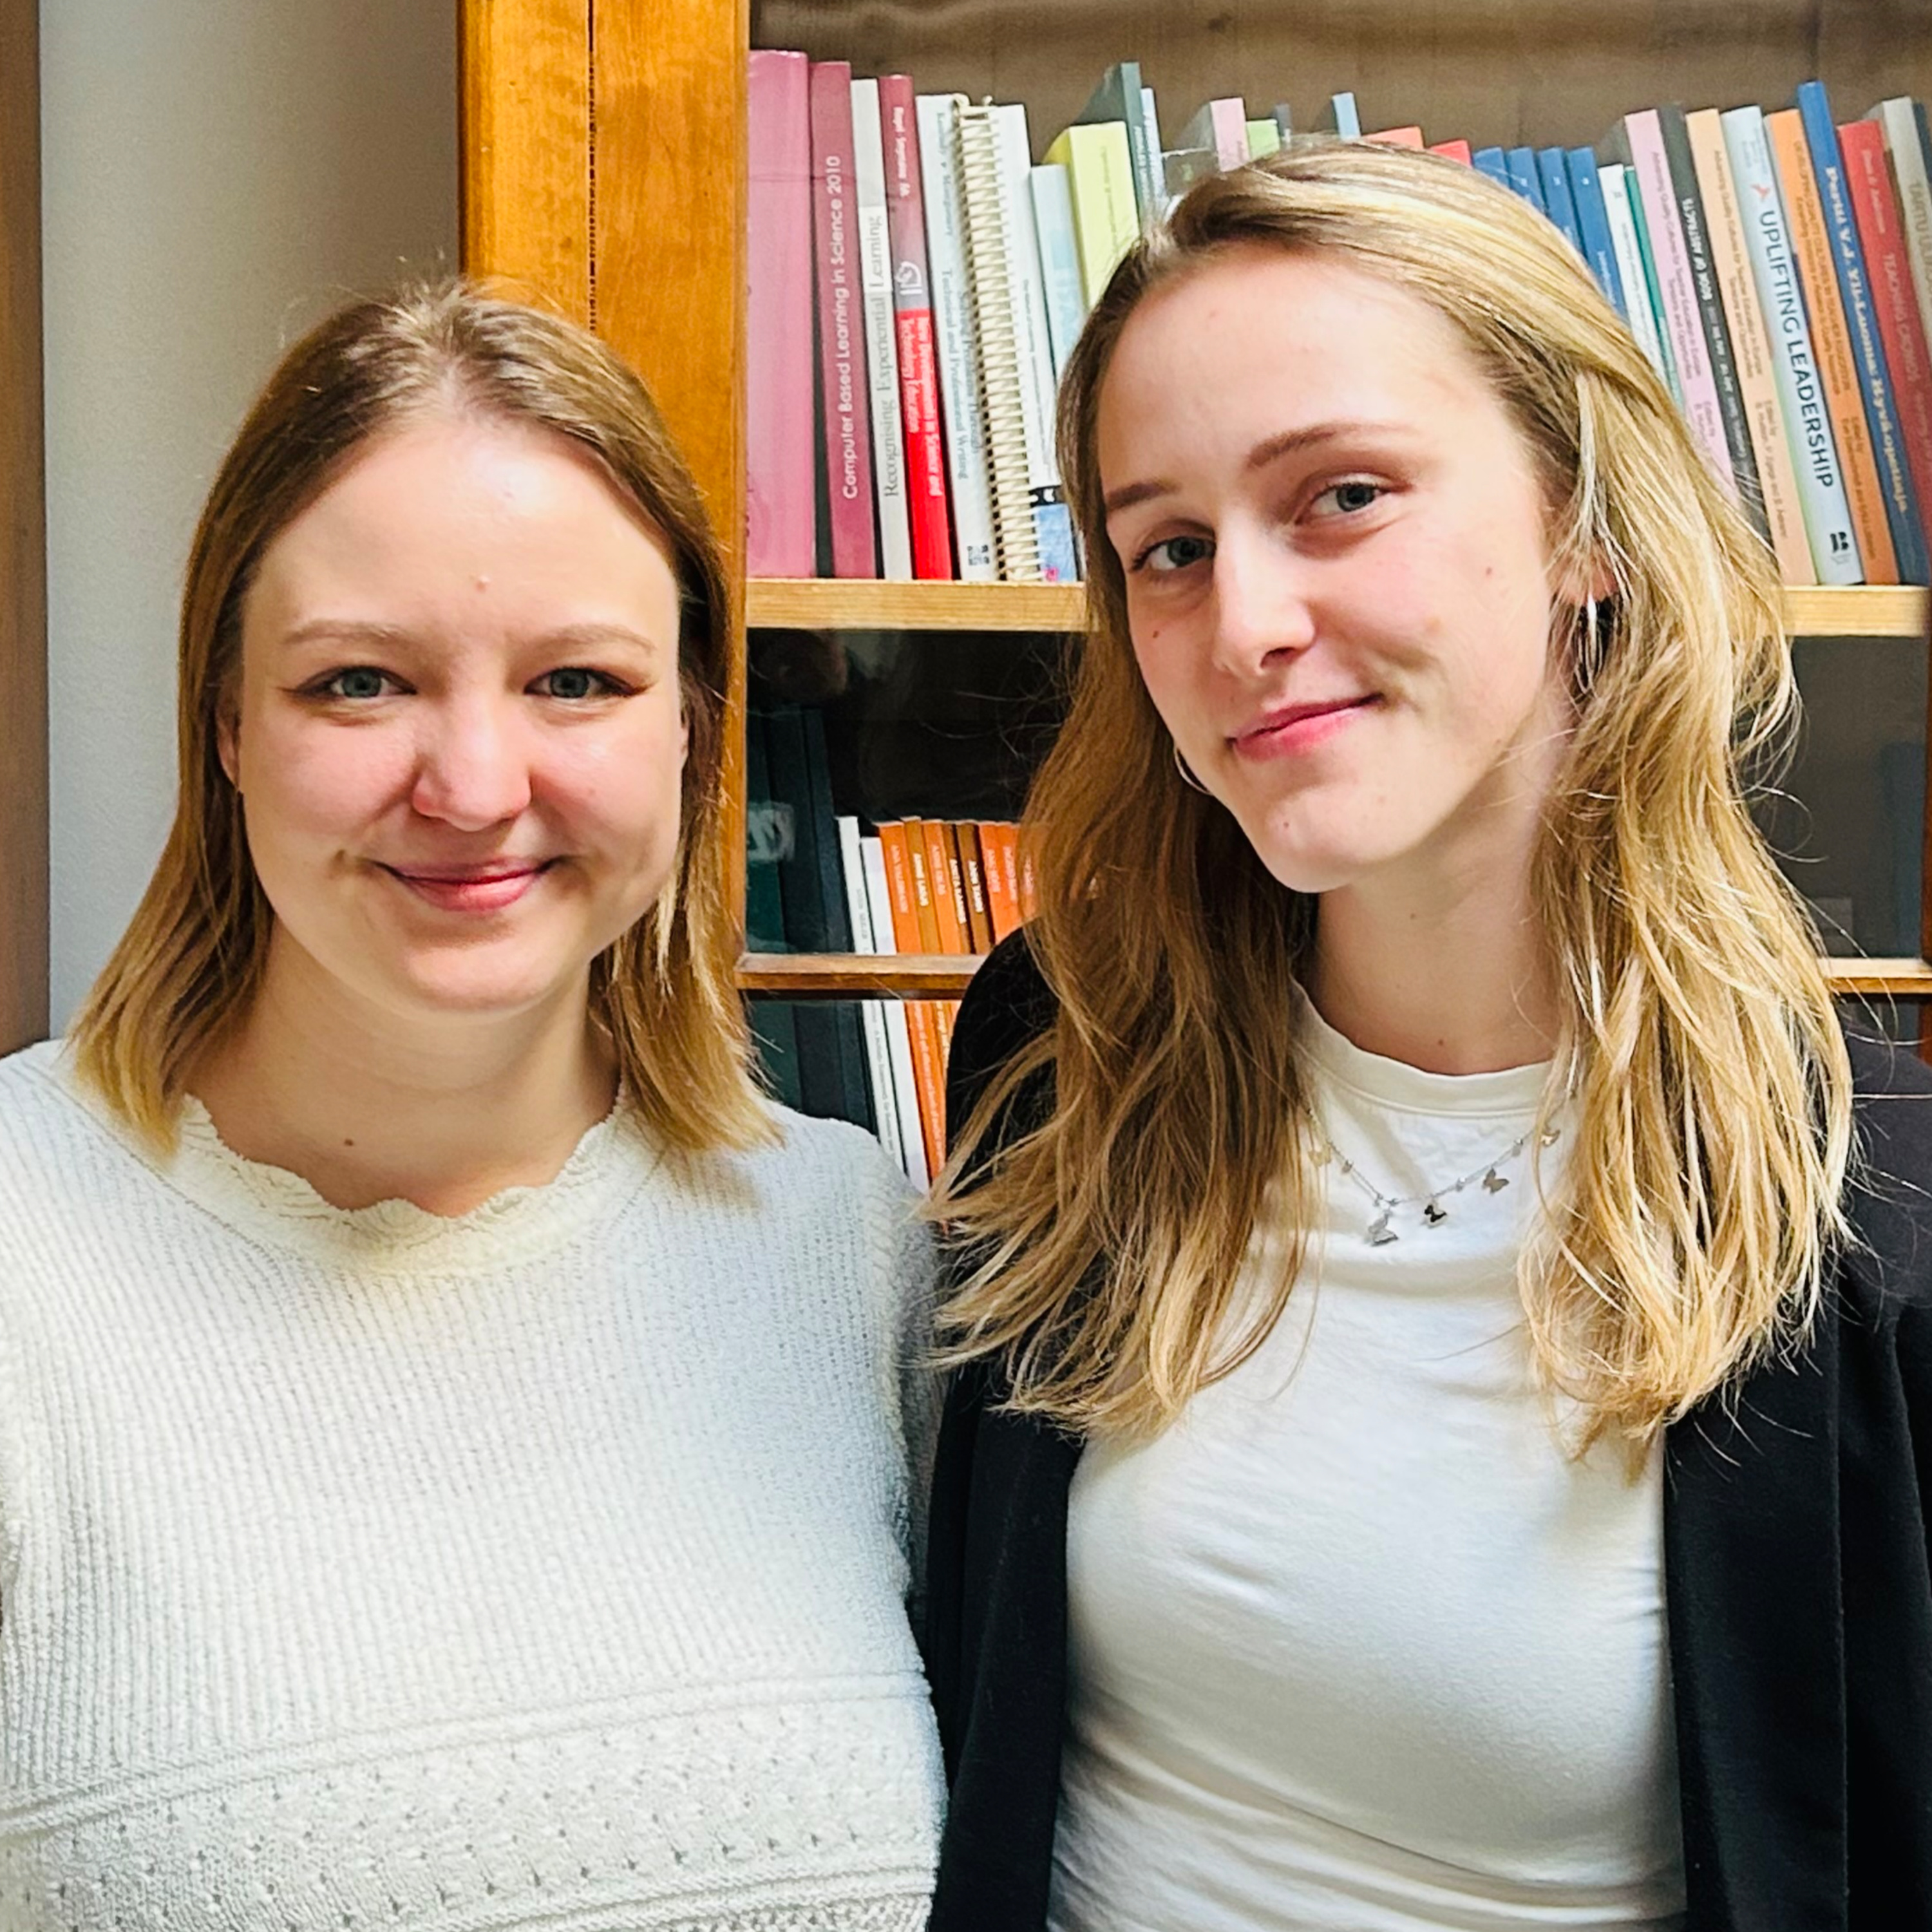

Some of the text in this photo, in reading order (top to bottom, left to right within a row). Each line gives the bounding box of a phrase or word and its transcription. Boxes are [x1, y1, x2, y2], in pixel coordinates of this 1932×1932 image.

[1824, 166, 1847, 224] Pertti
[1680, 197, 1713, 301] BOOK OF ABSTRACTS
[1679, 298, 1699, 338] Education
[1742, 298, 1756, 335] Education
[1846, 267, 1880, 376] Yli-Luoma:
[1880, 252, 1909, 322] TEACHING
[825, 156, 859, 498] Computer Based Learning in Science 2010
[868, 216, 901, 497] Recognising Experiential Learning
[1757, 209, 1835, 489] UPLIFTING LEADERSHIP
[941, 268, 970, 479] Technical and Professional Writing
[1868, 377, 1893, 433] Hyvä
[925, 433, 941, 473] Science
[929, 475, 942, 496] and
[1880, 433, 1909, 513] opettaja
